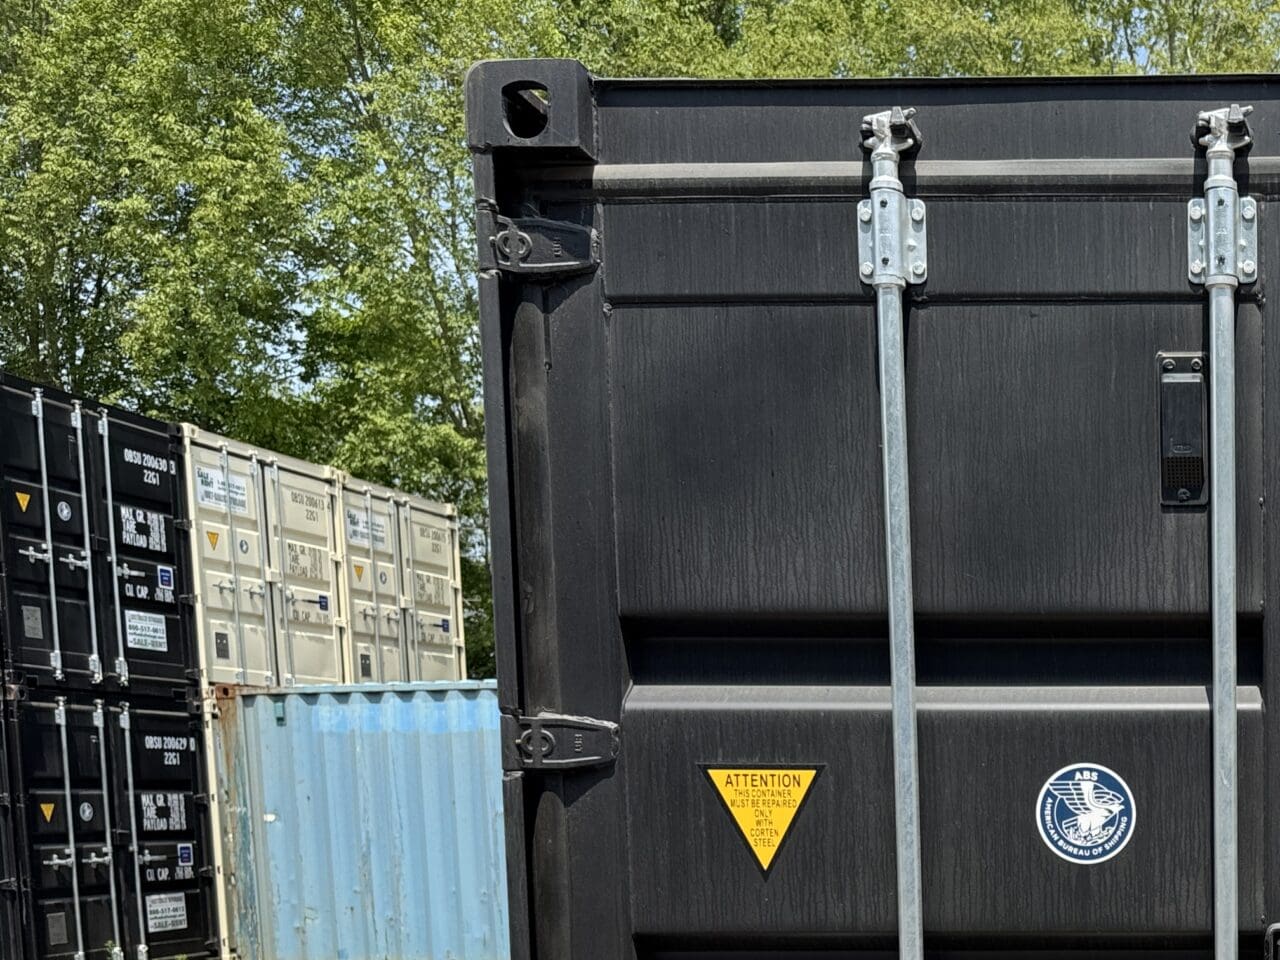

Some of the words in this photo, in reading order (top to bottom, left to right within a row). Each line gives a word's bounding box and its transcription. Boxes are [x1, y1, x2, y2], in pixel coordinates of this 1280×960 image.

[1074, 770, 1099, 781] ABS
[725, 774, 801, 787] ATTENTION
[734, 789, 750, 798] THIS
[751, 789, 792, 798] CONTAINER
[730, 799, 749, 808] MUST
[751, 799, 760, 808] BE
[762, 799, 797, 808] REPAIRED
[754, 809, 773, 818] ONLY
[755, 819, 773, 827] WITH
[1044, 797, 1060, 841] AMERICAN
[1057, 840, 1090, 856] BUREAU
[1092, 848, 1103, 857] OF
[1104, 816, 1128, 850] SHIPPING
[750, 828, 779, 837] CORTEN
[754, 838, 775, 847] STEEL
